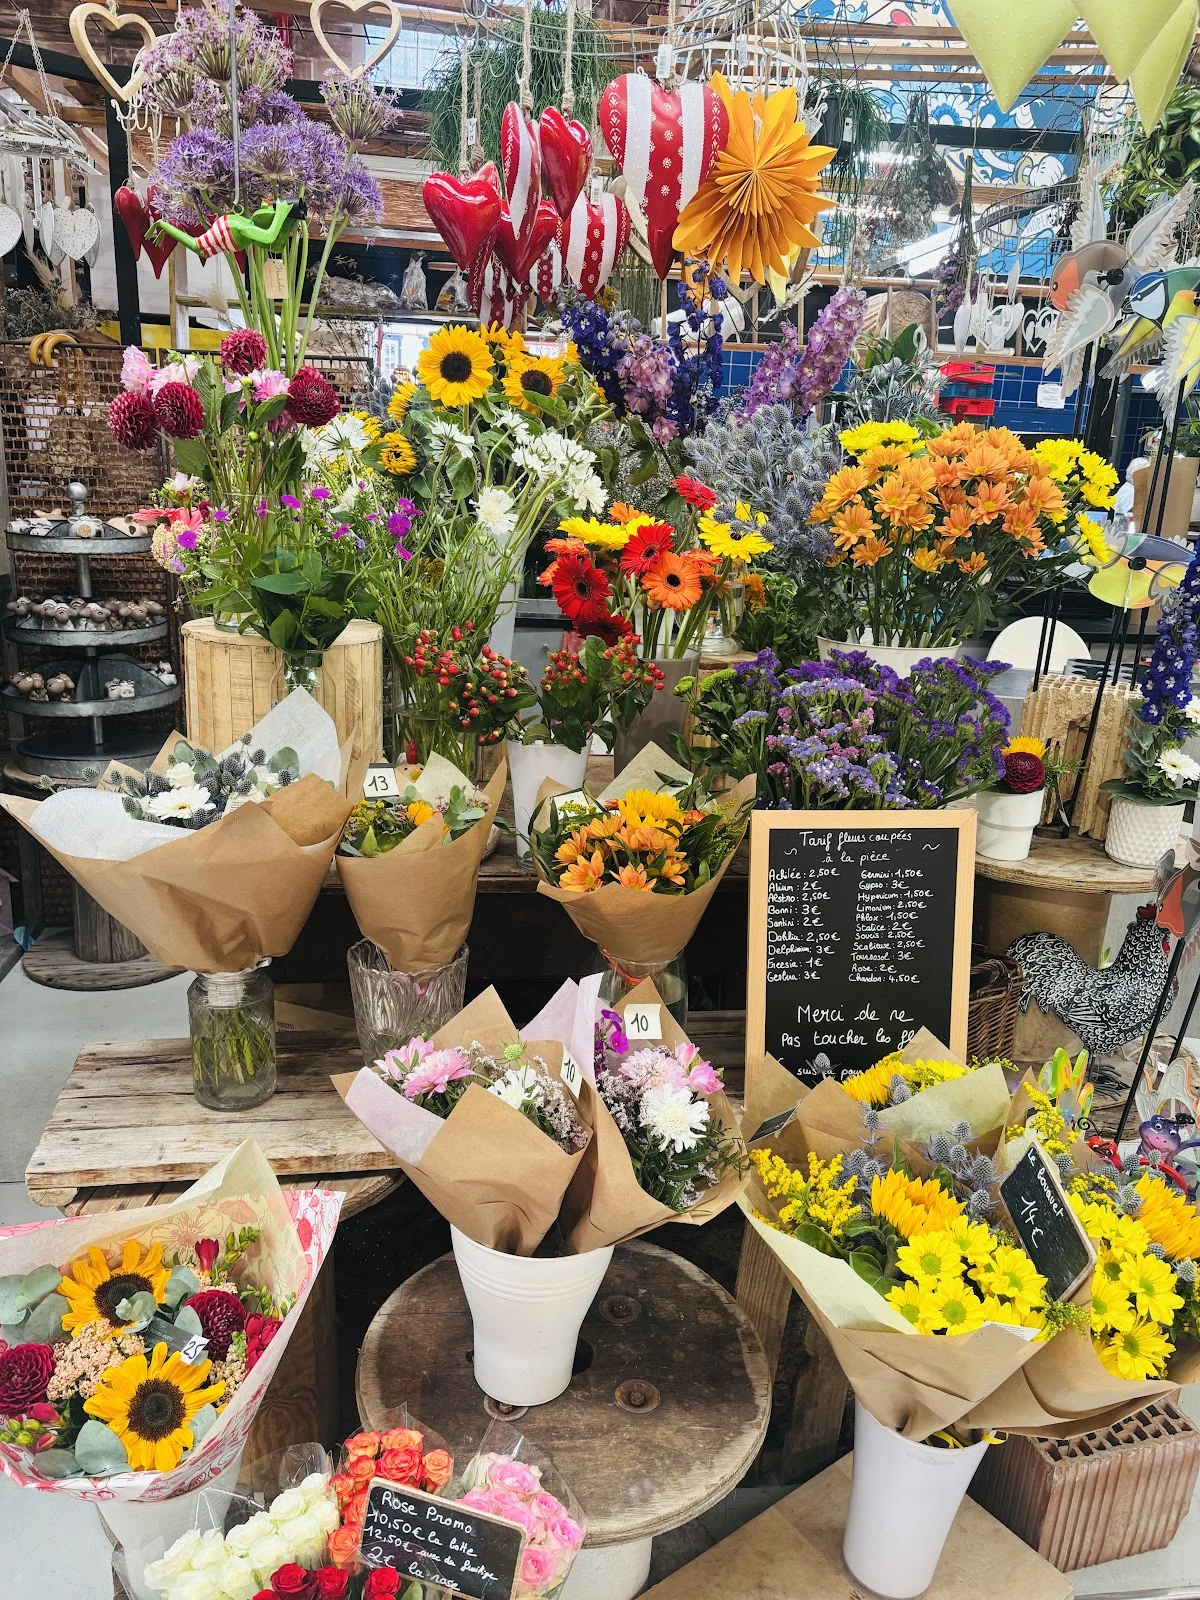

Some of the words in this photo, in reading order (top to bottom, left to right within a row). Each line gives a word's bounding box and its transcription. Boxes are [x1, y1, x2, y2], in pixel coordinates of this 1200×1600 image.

[368, 775, 389, 791] 13
[799, 831, 832, 851] Tarif
[837, 832, 866, 851] fleurs
[869, 830, 912, 844] coupées
[822, 853, 833, 863] à
[840, 851, 854, 863] la
[860, 851, 890, 866] pièce
[809, 868, 840, 878] 2,50€
[895, 869, 923, 878] 1,50€
[802, 881, 822, 890] 2€
[891, 880, 909, 889] 3€
[802, 892, 830, 902] 2,50€
[904, 890, 933, 898] 1,50€
[801, 904, 821, 915] 3€
[897, 901, 927, 909] 2,50€
[886, 911, 918, 920] 1,50€
[803, 917, 824, 926] 2€
[892, 922, 912, 930] 2€
[806, 932, 840, 943] 2,50€
[888, 931, 915, 939] 2,50€
[816, 945, 835, 954] 3€
[897, 940, 925, 949] 2,50€
[897, 951, 914, 960] 3€
[805, 957, 823, 968] 1€
[879, 964, 897, 973] 2€
[804, 971, 820, 979] 3€
[889, 974, 920, 983] 4,50€
[797, 1004, 844, 1023] Merci
[854, 1003, 880, 1021] de
[890, 1009, 914, 1022] ne
[631, 1013, 649, 1033] 10
[814, 1029, 868, 1046] toucher
[875, 1028, 891, 1043] les
[564, 1058, 575, 1083] 10
[183, 1340, 205, 1360] 25
[382, 1491, 417, 1515] Rose
[426, 1506, 473, 1533] Promo
[368, 1509, 425, 1540] 10,50€
[428, 1531, 443, 1546] la
[449, 1537, 478, 1557] botte
[364, 1525, 412, 1552] 12,50€
[417, 1550, 441, 1562] avec
[444, 1556, 456, 1566] du
[367, 1546, 396, 1569] 2€
[408, 1562, 424, 1578] la
[431, 1574, 461, 1591] rose
